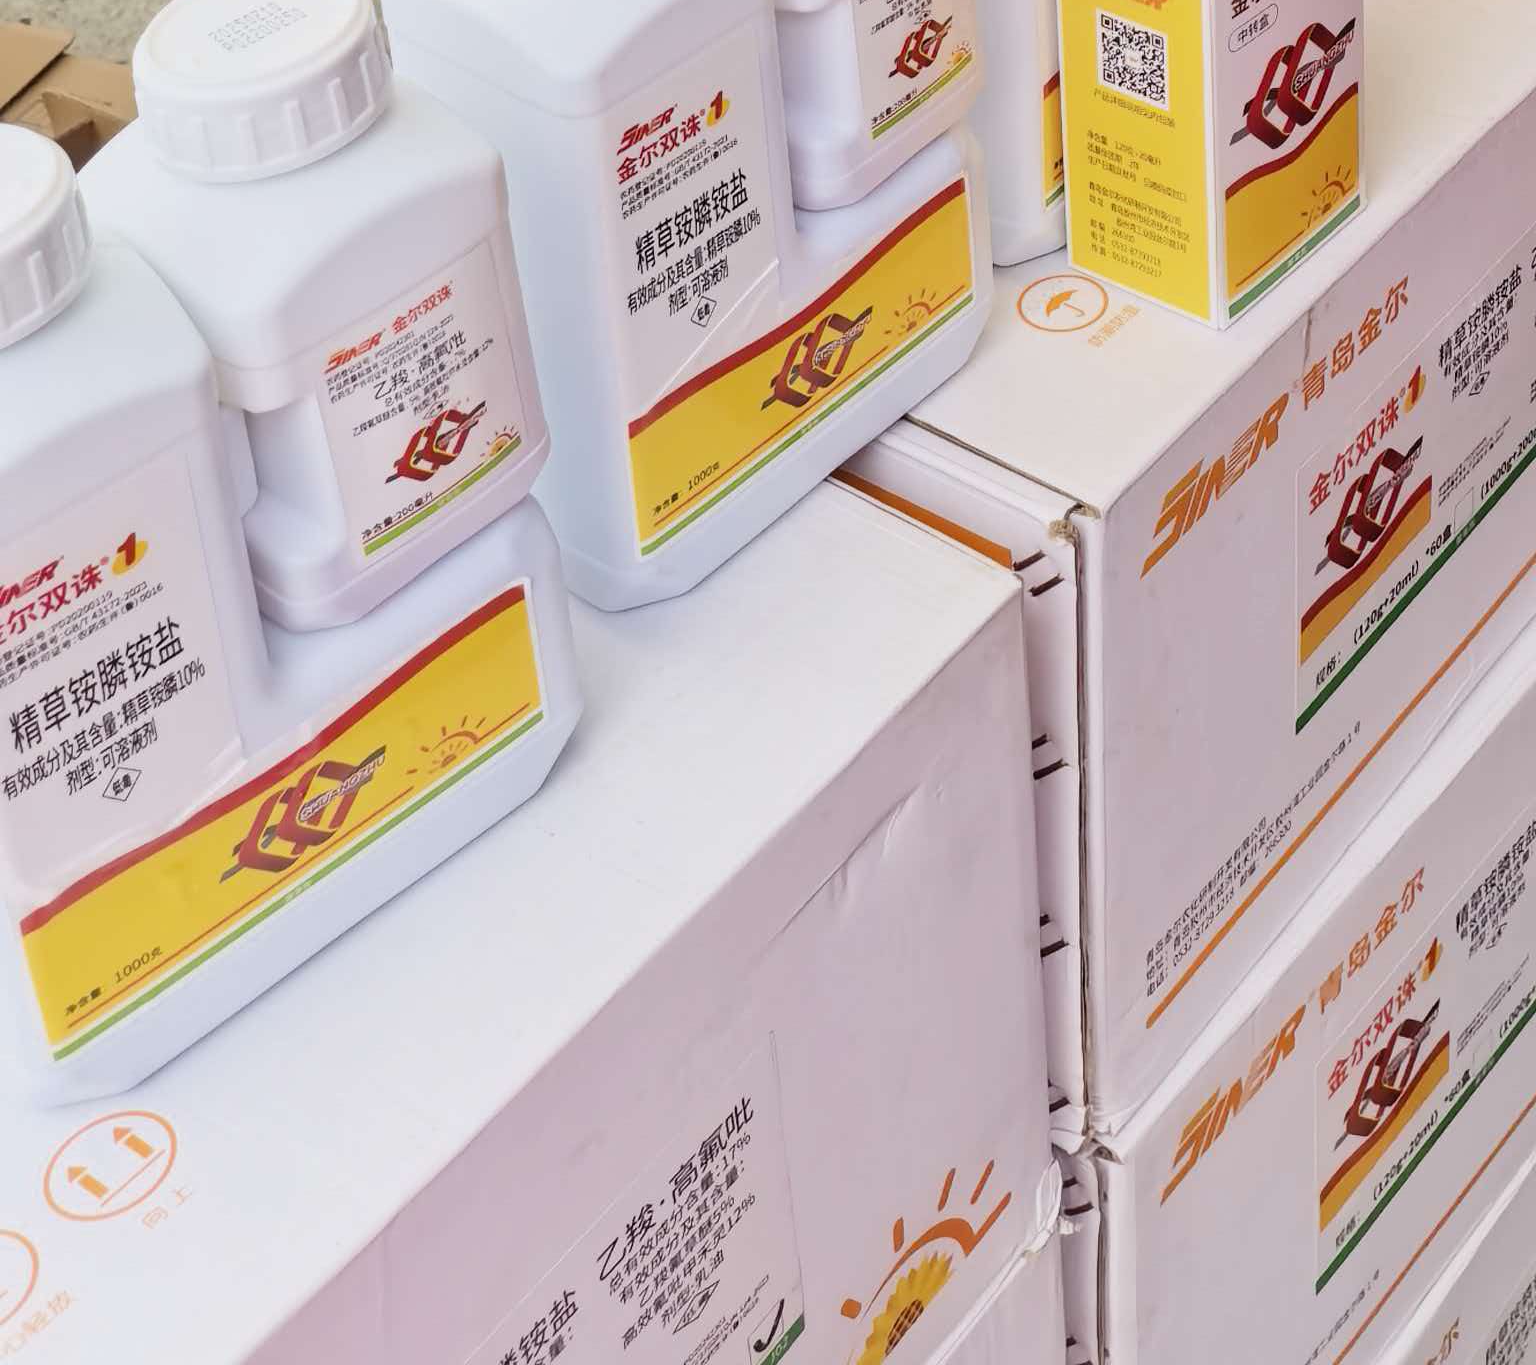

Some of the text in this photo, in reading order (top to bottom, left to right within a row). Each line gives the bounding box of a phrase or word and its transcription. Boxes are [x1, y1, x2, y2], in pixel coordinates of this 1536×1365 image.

[617, 113, 702, 185] 金尔双诛
[635, 168, 750, 275] 精草铵膦铵盐
[391, 283, 453, 335] 金尔双诛
[1301, 275, 1411, 411] 青岛金尔
[1308, 397, 1400, 517] 金尔双诛
[9, 615, 185, 755] 精草铵膦铵盐
[66, 717, 158, 796] 剂型:可溶液剂
[1320, 866, 1426, 1015] 青岛金尔
[1326, 979, 1415, 1100] 金尔双诛
[596, 1095, 755, 1282] 乙羧·高氟吡
